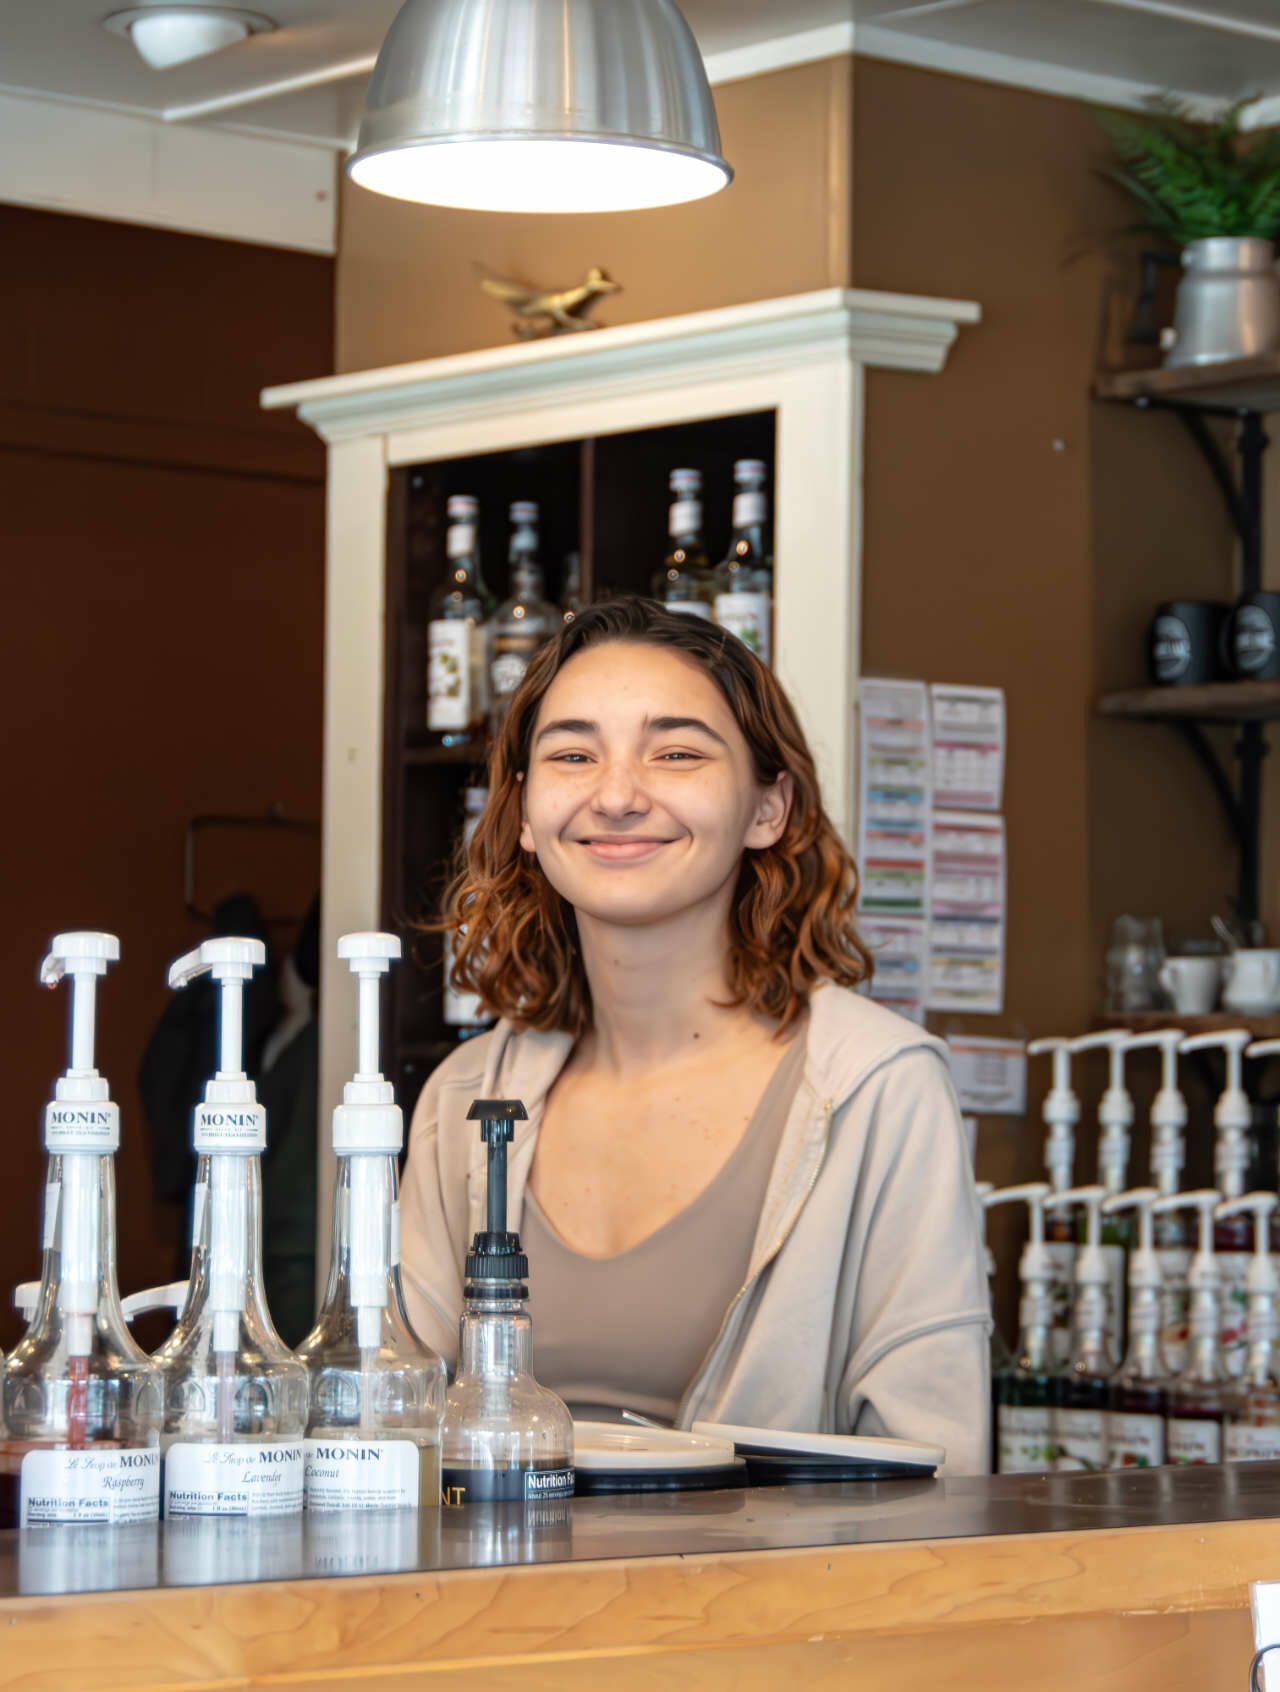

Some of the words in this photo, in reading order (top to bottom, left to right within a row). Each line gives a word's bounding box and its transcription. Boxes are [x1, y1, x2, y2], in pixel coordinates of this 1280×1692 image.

[259, 1447, 302, 1463] MONIN
[316, 1447, 382, 1461] MONIN
[241, 1470, 282, 1484] Lavender
[304, 1465, 340, 1479] Coconut
[102, 1475, 145, 1491] Raspberry
[528, 1474, 567, 1489] Nutrition
[28, 1497, 75, 1507] Nutrition
[79, 1497, 109, 1507] Facts
[169, 1491, 214, 1501] Nutrition
[217, 1491, 248, 1501] Facts
